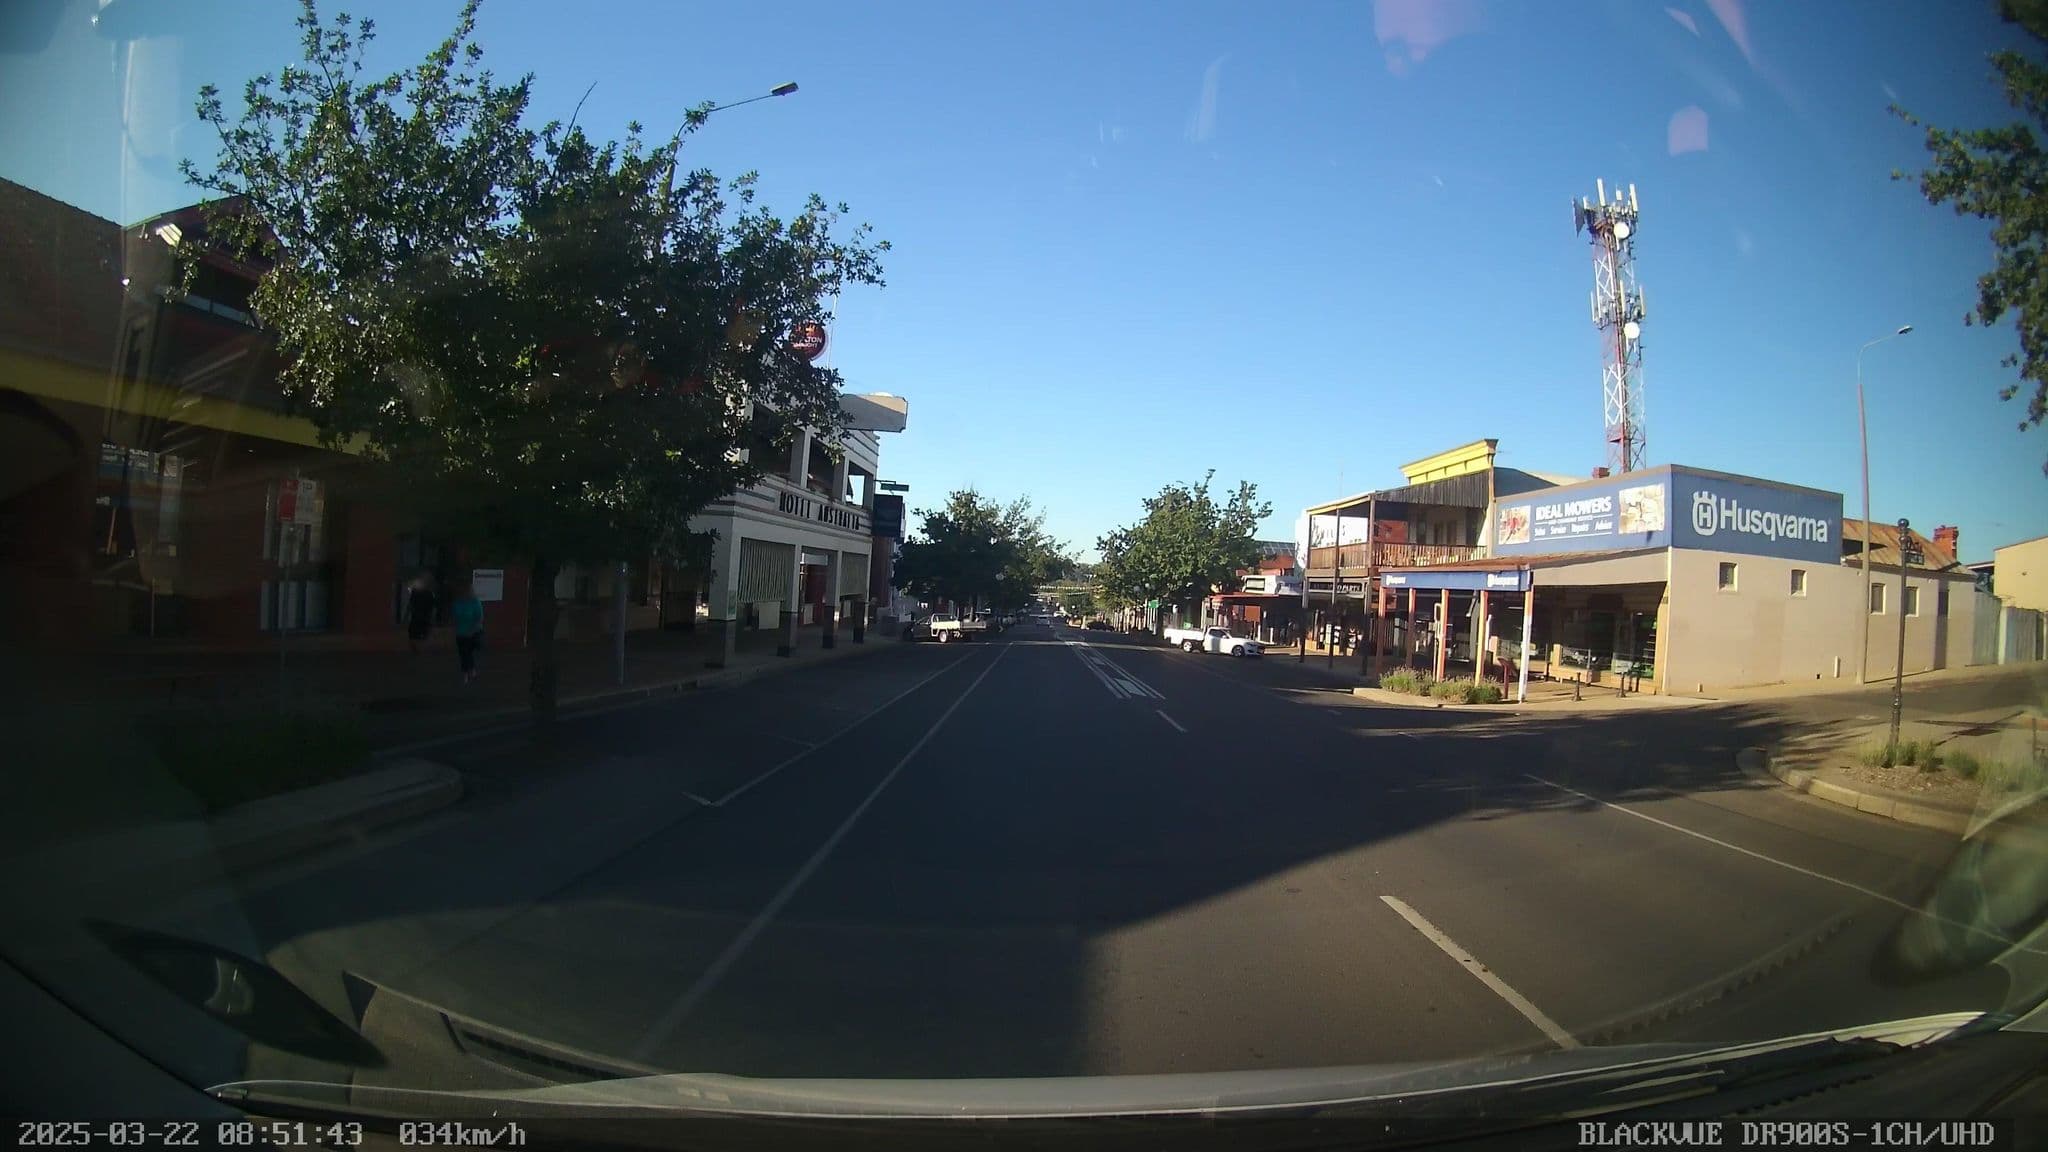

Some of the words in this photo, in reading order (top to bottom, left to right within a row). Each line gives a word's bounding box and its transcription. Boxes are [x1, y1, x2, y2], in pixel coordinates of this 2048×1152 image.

[1535, 505, 1564, 521] IDEAL
[1564, 496, 1612, 516] MOWERS
[1720, 498, 1828, 542] Husqvarna
